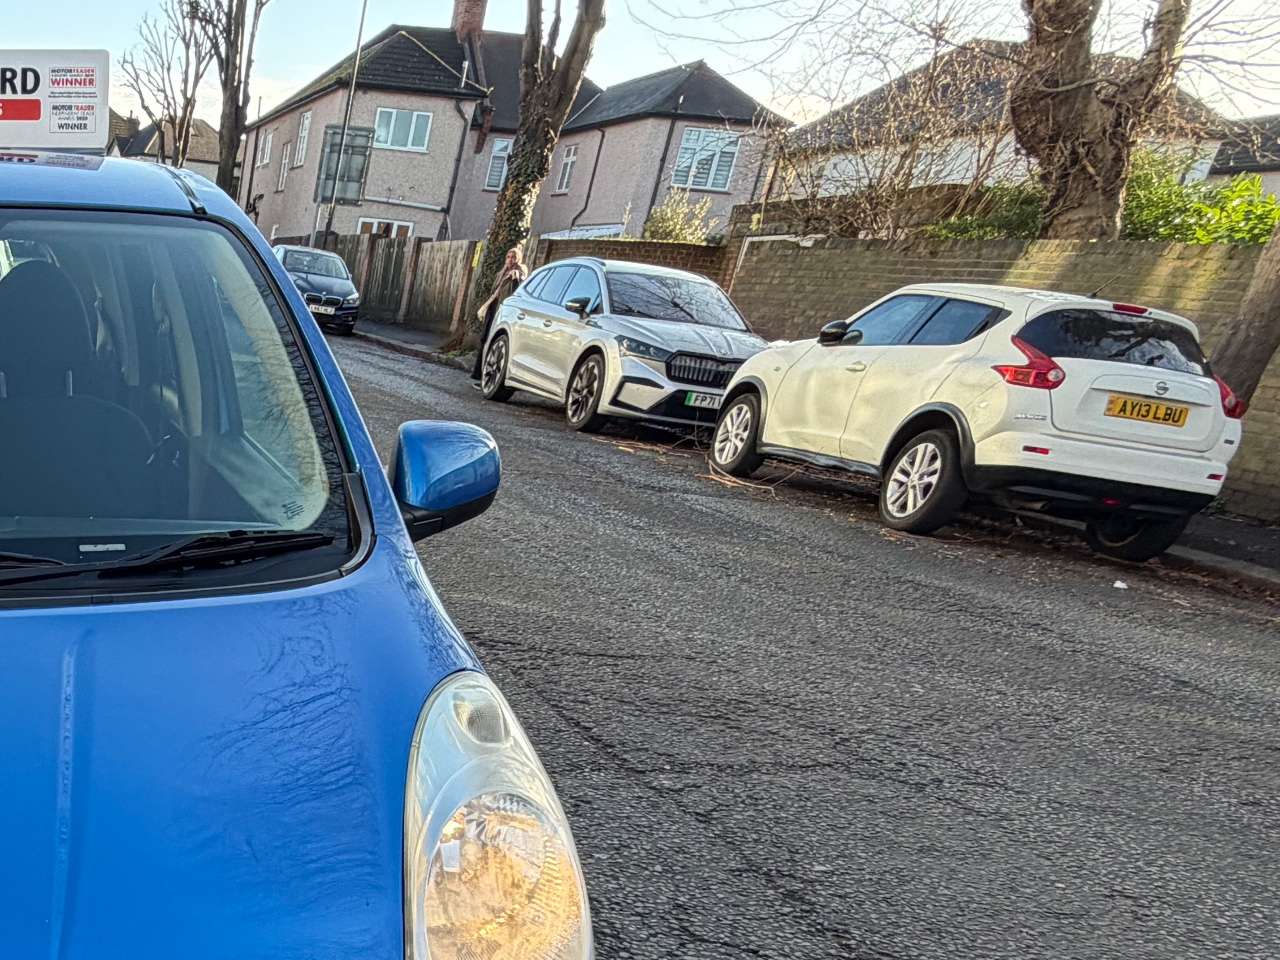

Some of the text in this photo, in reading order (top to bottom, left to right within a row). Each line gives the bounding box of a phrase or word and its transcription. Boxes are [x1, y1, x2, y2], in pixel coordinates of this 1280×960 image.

[50, 77, 95, 87] WINNER
[57, 122, 88, 131] WINNER
[1117, 399, 1184, 423] AY13 LBU
